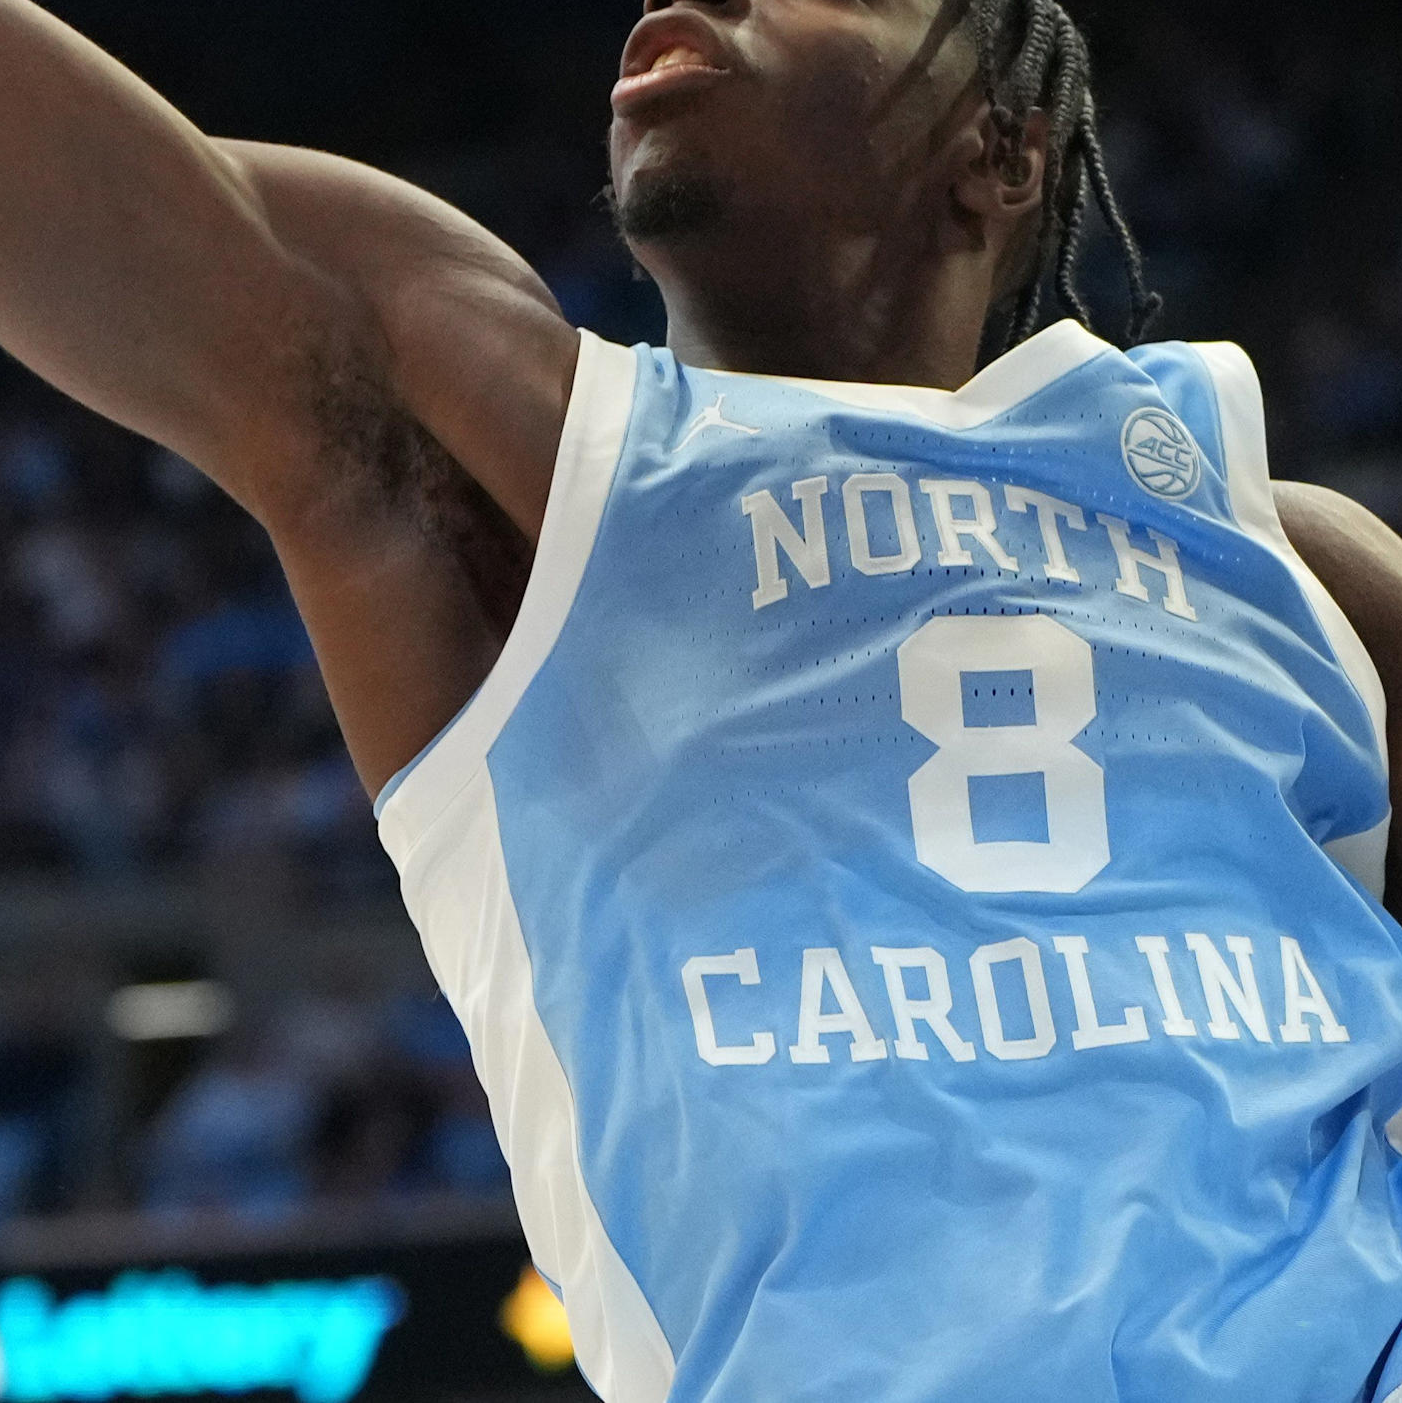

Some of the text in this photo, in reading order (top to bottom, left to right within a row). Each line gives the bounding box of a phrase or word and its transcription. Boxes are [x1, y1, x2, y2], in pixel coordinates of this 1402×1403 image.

[1136, 436, 1193, 470] ACC
[741, 473, 1198, 622] NORTH
[897, 614, 1111, 894] 8
[681, 933, 1350, 1067] CAROLINA
